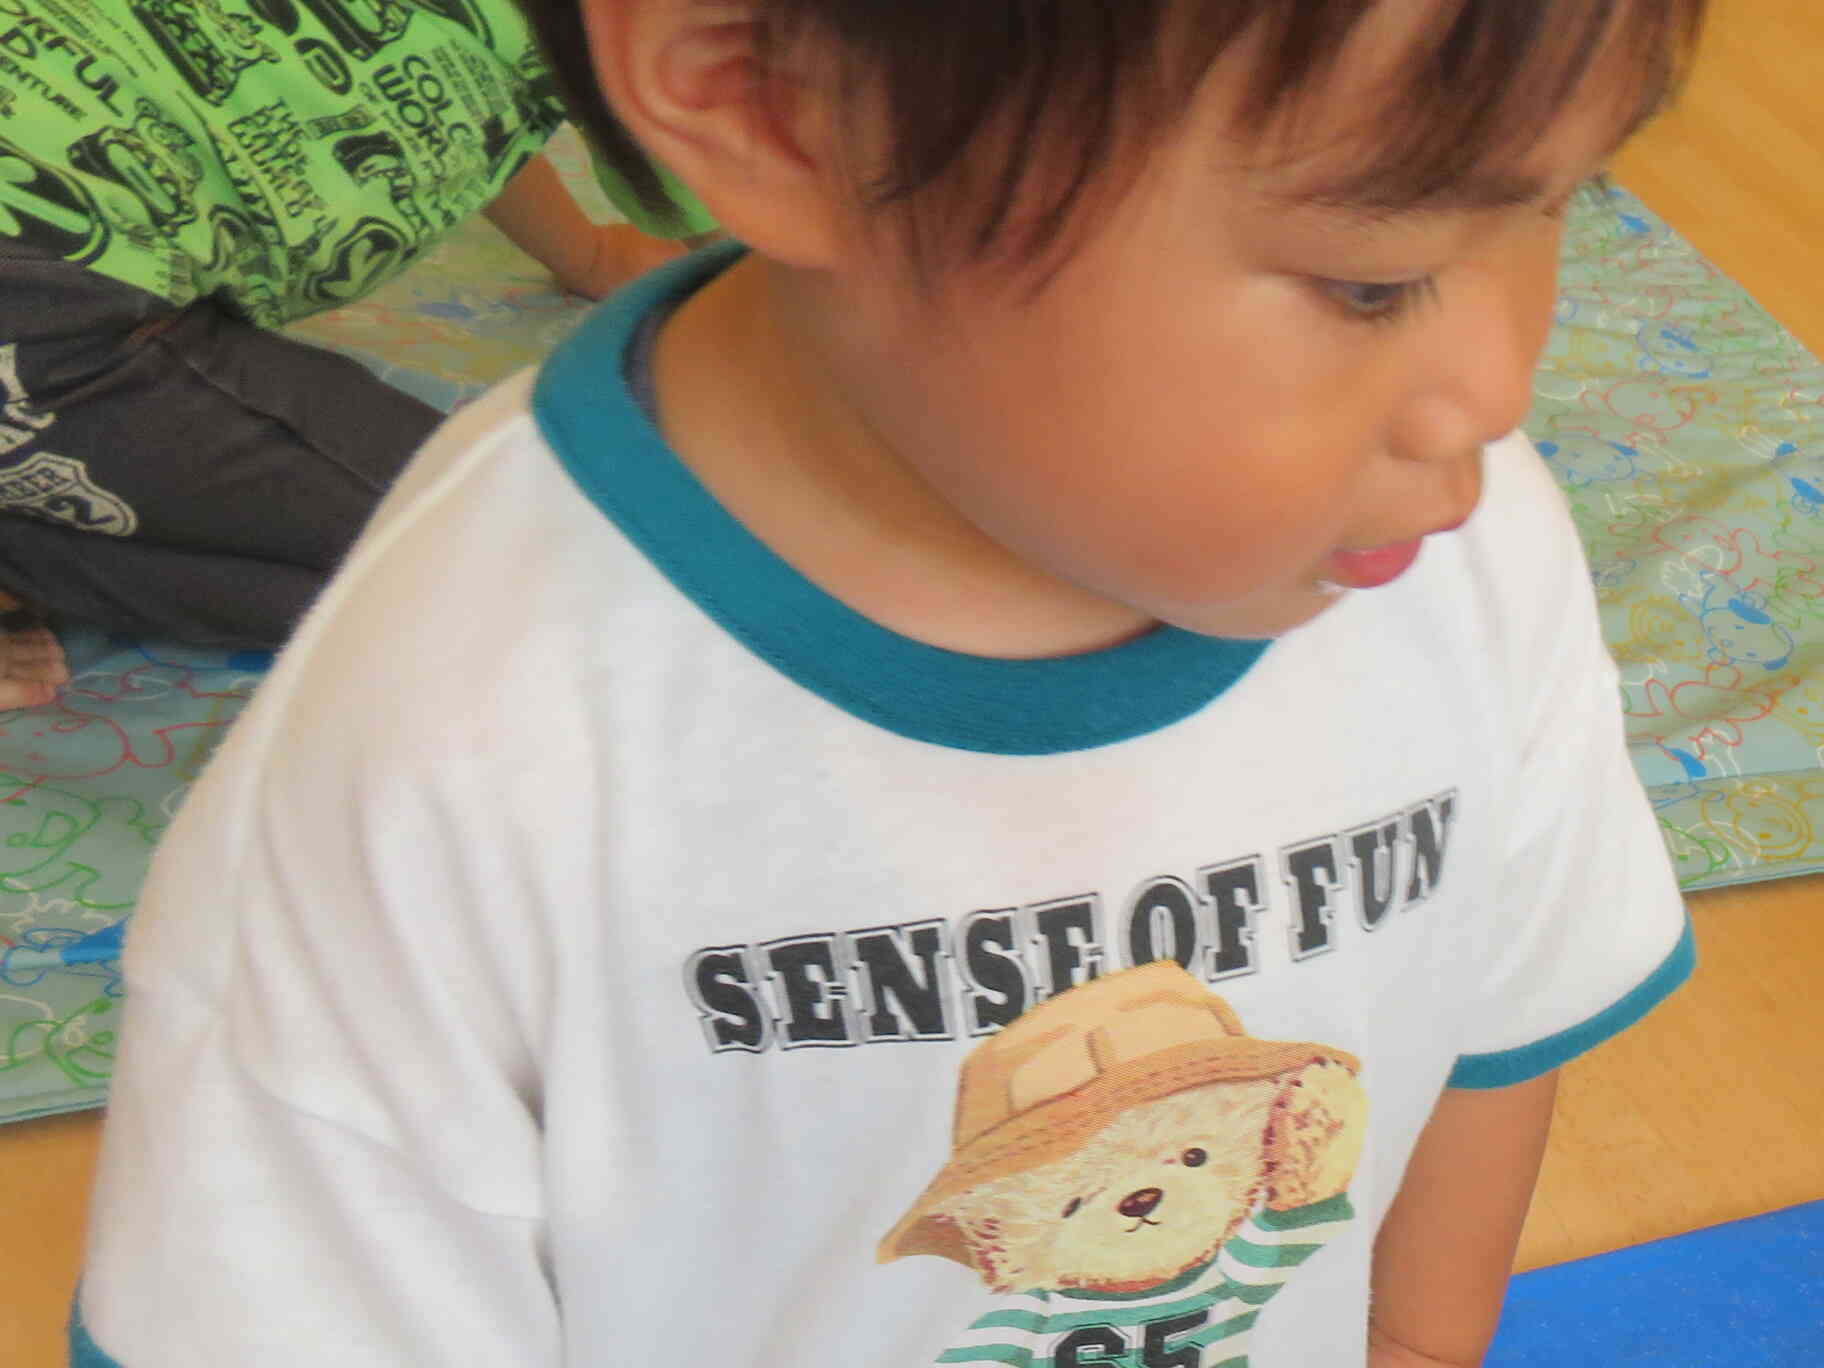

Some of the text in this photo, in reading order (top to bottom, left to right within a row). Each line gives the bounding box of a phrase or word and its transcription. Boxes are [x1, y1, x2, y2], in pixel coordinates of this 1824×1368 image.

[683, 787, 1459, 1053] SENSE OF FUN
